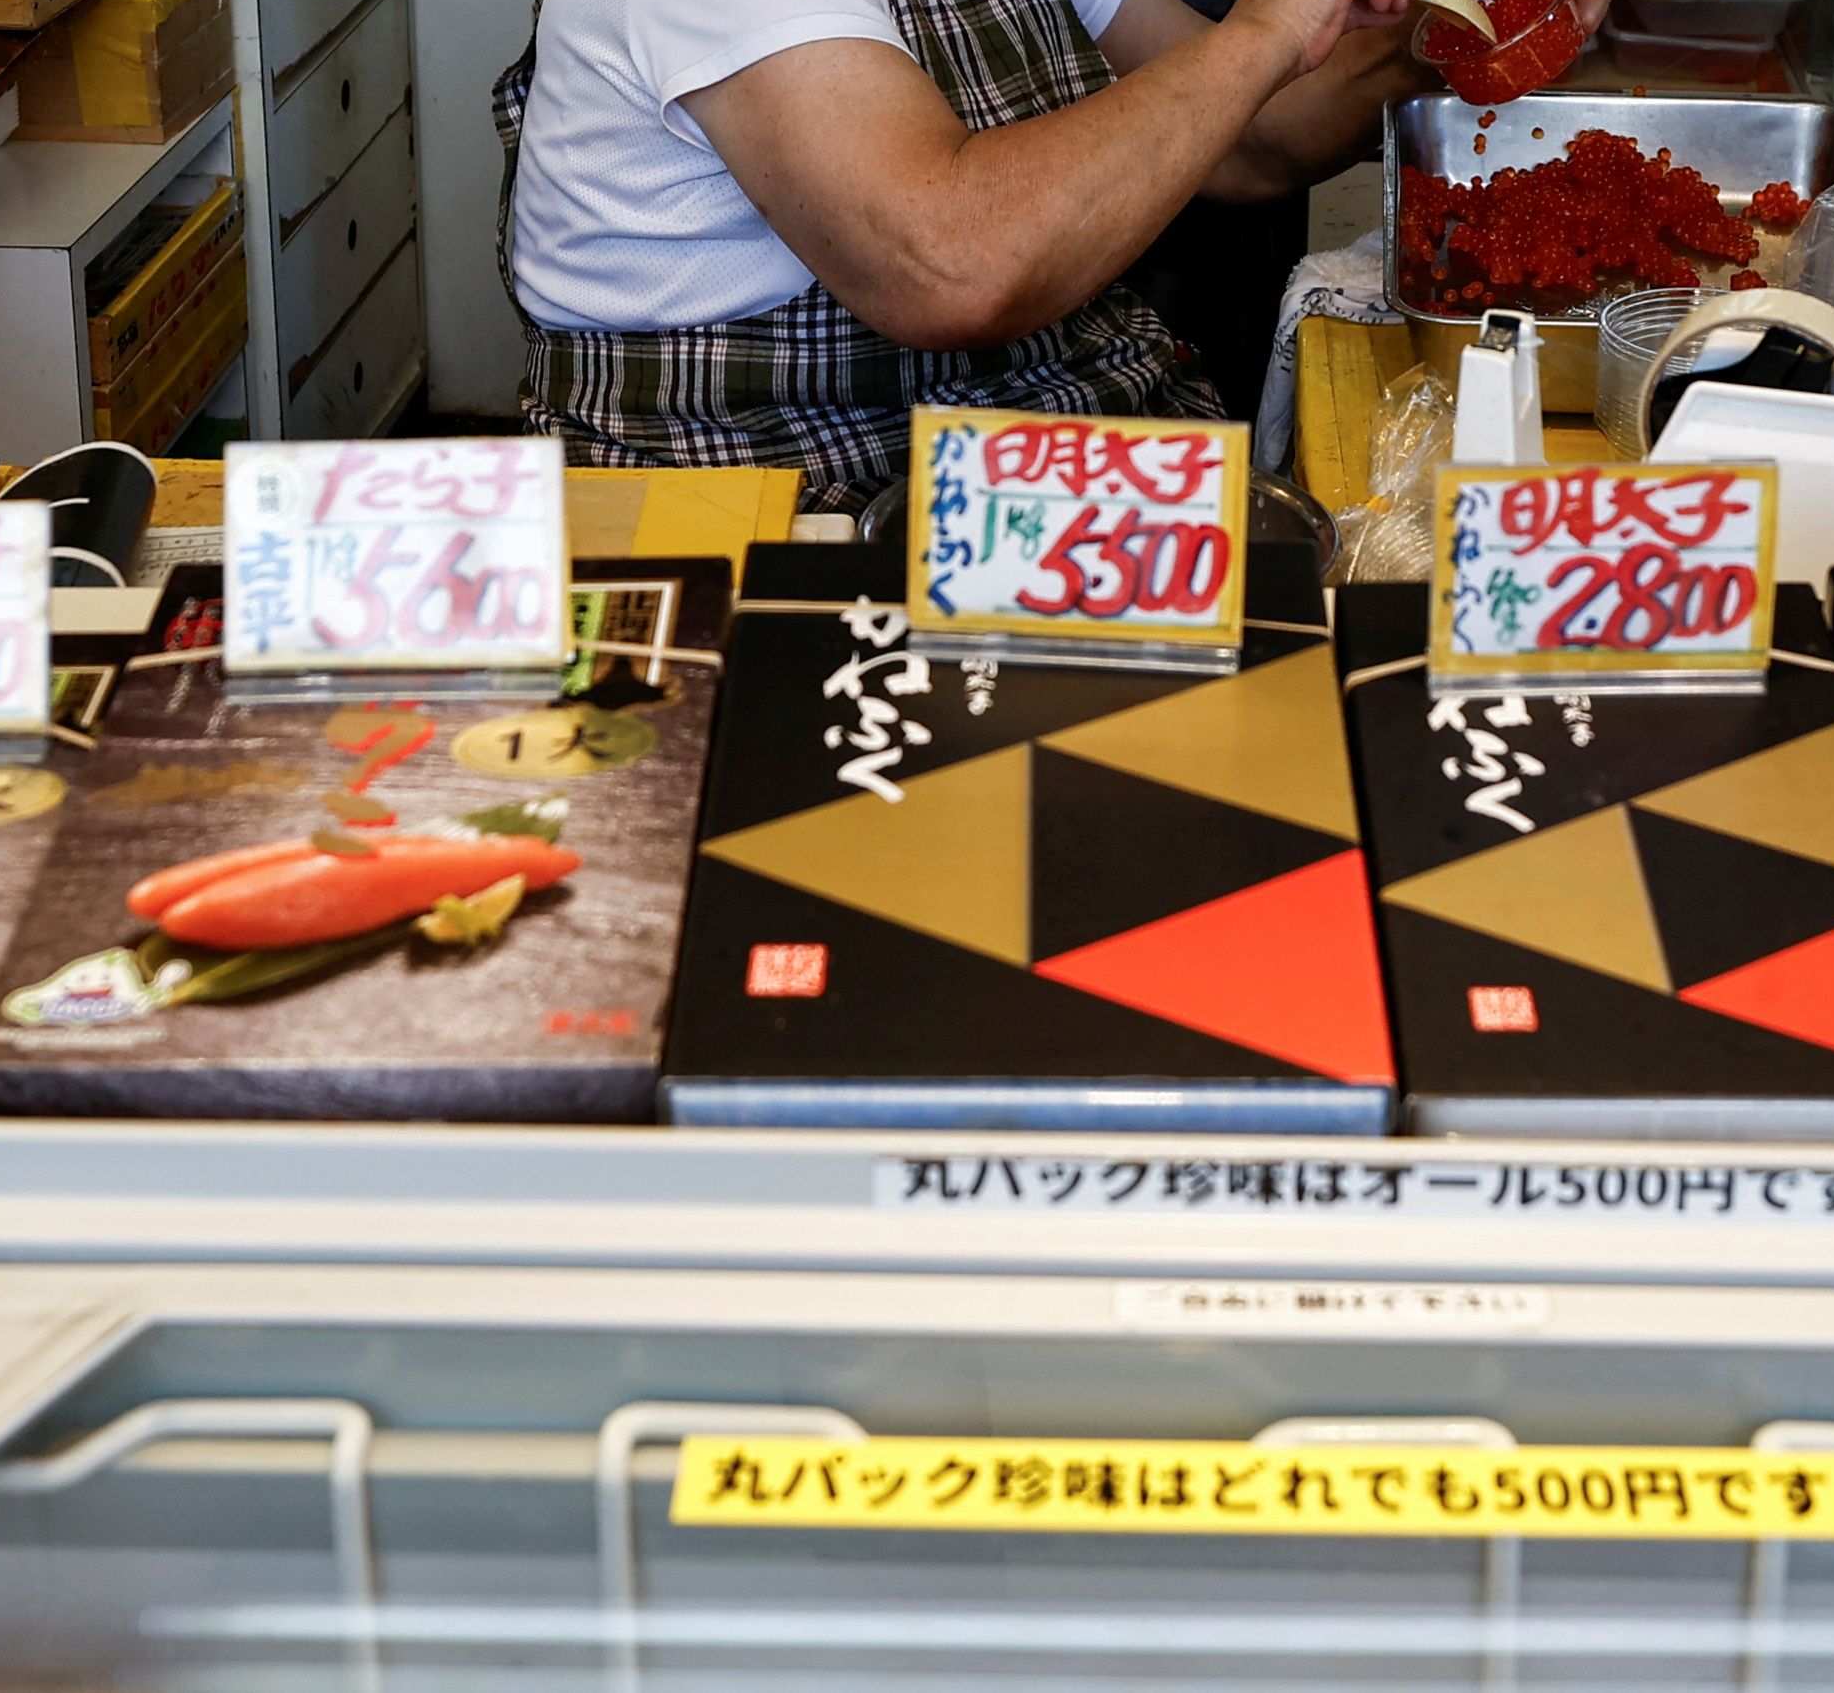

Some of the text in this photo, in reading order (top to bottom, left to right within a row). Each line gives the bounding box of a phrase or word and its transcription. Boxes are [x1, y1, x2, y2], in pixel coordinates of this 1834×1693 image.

[313, 439, 540, 525] たら子
[983, 423, 1224, 505] 明太子
[923, 423, 977, 616] かねふく
[1498, 468, 1749, 556] 明太子
[236, 530, 294, 653] 古平
[1444, 485, 1490, 654] かねふく
[709, 1449, 1834, 1518] 丸パック珍味はどれでも500円です
